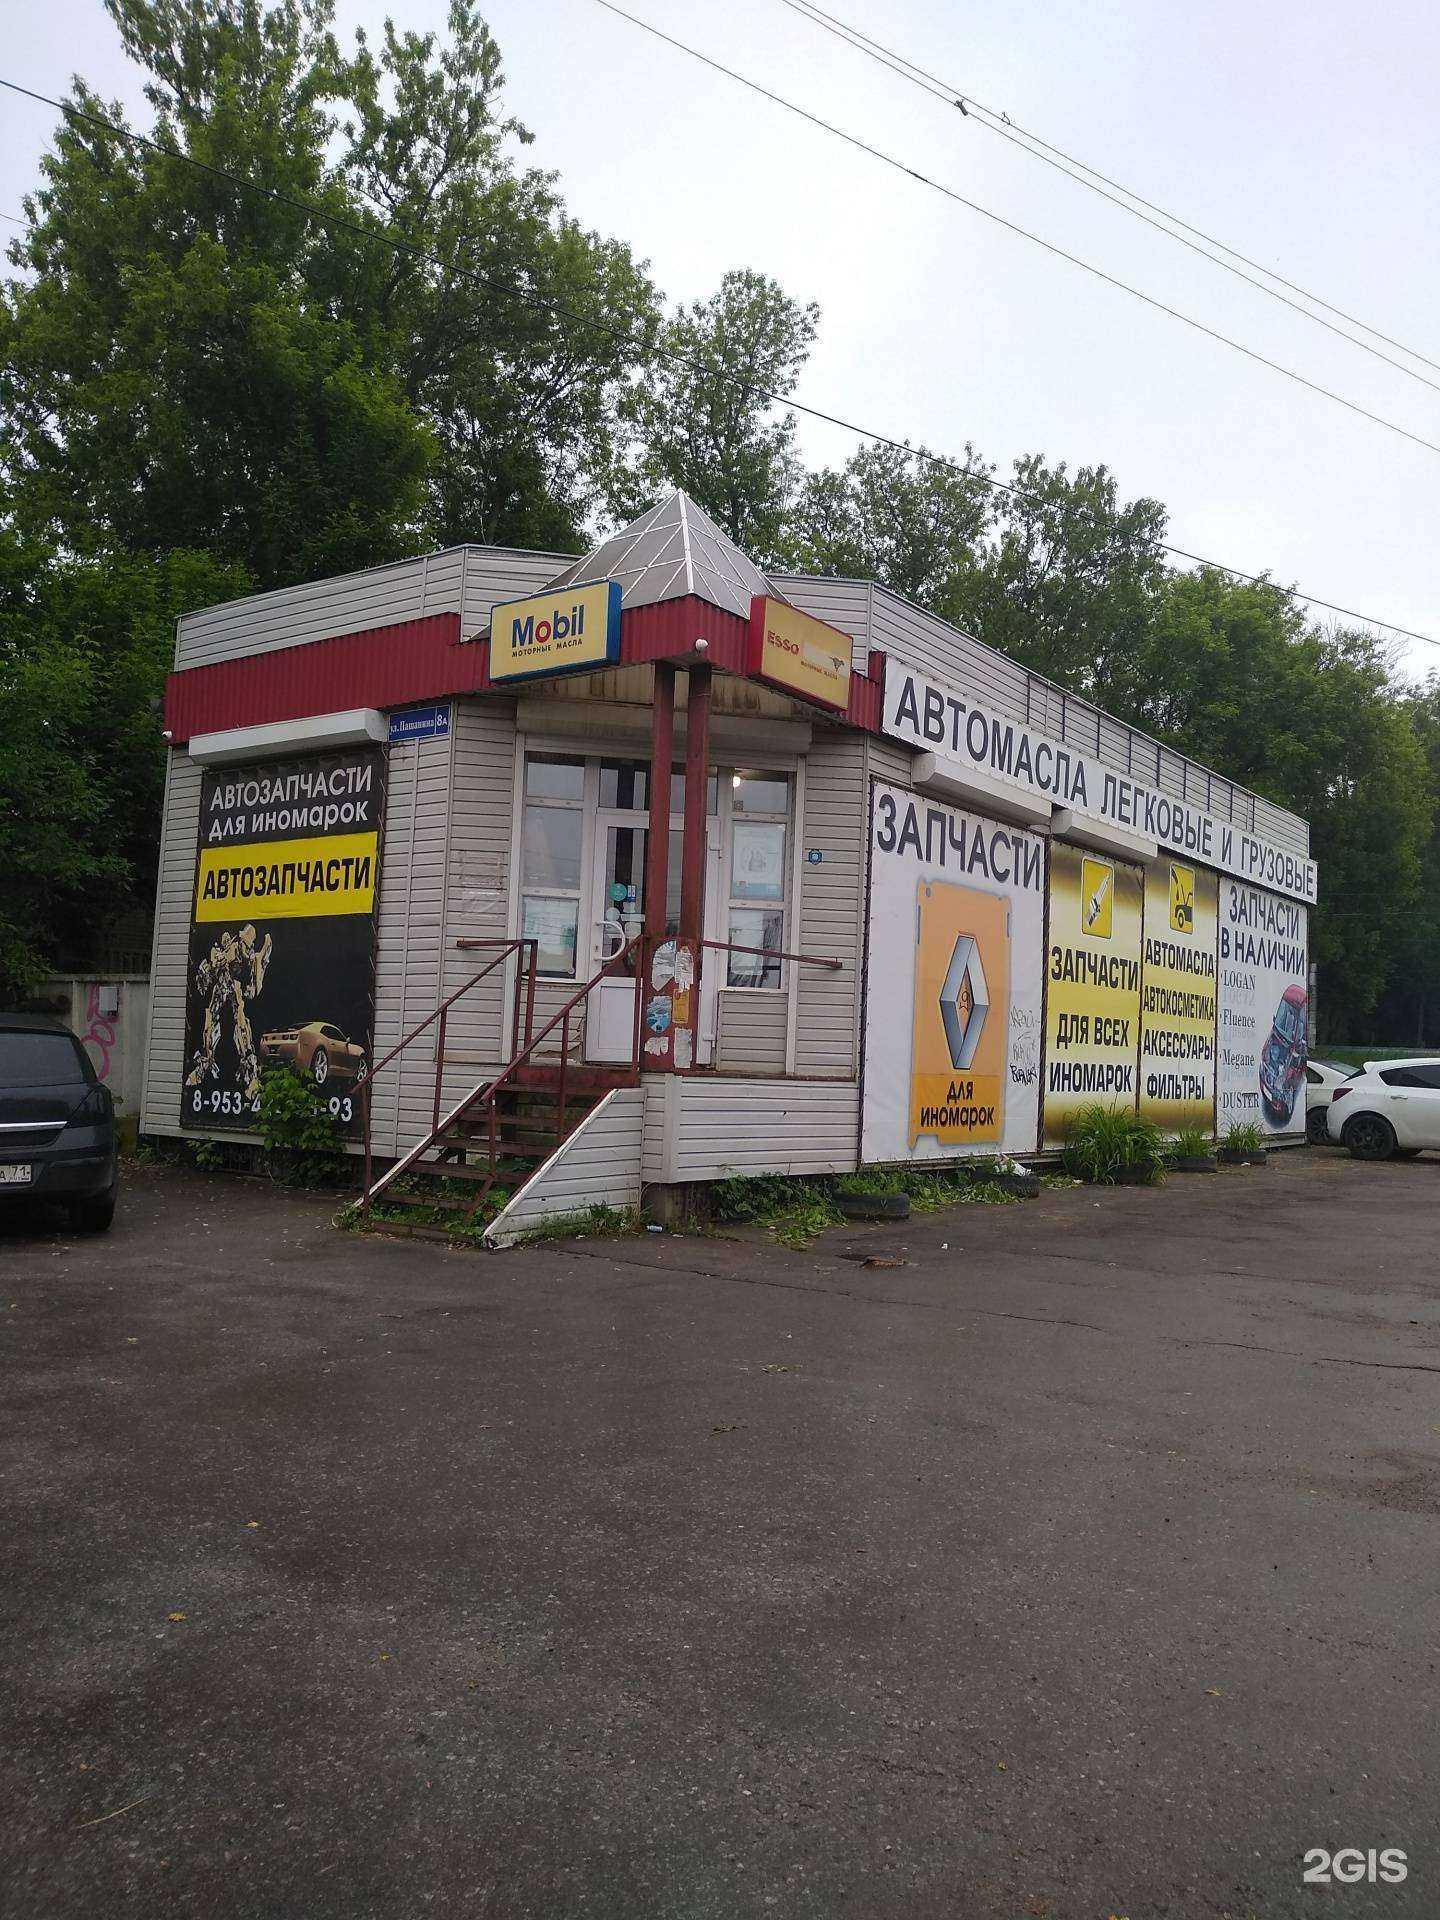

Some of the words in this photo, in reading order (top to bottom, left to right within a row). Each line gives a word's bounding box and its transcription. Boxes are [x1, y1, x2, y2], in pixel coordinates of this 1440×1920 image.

[512, 605, 584, 648] Mobil
[512, 645, 551, 657] МОТОРНЫЕ
[556, 639, 583, 650] МАСЛА
[210, 765, 372, 811] АВТОЗАПЧАСТИ
[894, 676, 1088, 807] АВТОМАСЛА
[1101, 773, 1212, 858] ЛЕГКОВЫЕ
[1222, 830, 1233, 866] И
[1240, 836, 1315, 898] ГРУЗОВЫЕ
[876, 793, 1041, 892] ЗАПЧАСТИ
[203, 856, 371, 901] АВТОЗАПЧАСТИ
[1229, 885, 1300, 940] ЗАПЧАСТИ
[1051, 946, 1138, 992] ЗАПЧАСТИ
[1144, 938, 1215, 979] АВТОМАСЛА
[1221, 927, 1230, 959] В
[1235, 929, 1305, 977] НАЛИЧИИ
[1223, 969, 1256, 990] LOGAN
[1143, 985, 1215, 1021] АВТОКОСМЕТИКА
[1223, 1008, 1256, 1028] Fluence
[1056, 1013, 1089, 1050] ДЛЯ
[1094, 1017, 1130, 1047] ВСЕХ
[1143, 1029, 1213, 1061] АКСЕССУАРЫ
[1050, 1062, 1133, 1093] ИНОМАРОК
[1222, 1049, 1255, 1069] Megane
[1146, 1073, 1205, 1100] ФИЛЬТРЫ
[1222, 1092, 1260, 1109] DUSTER
